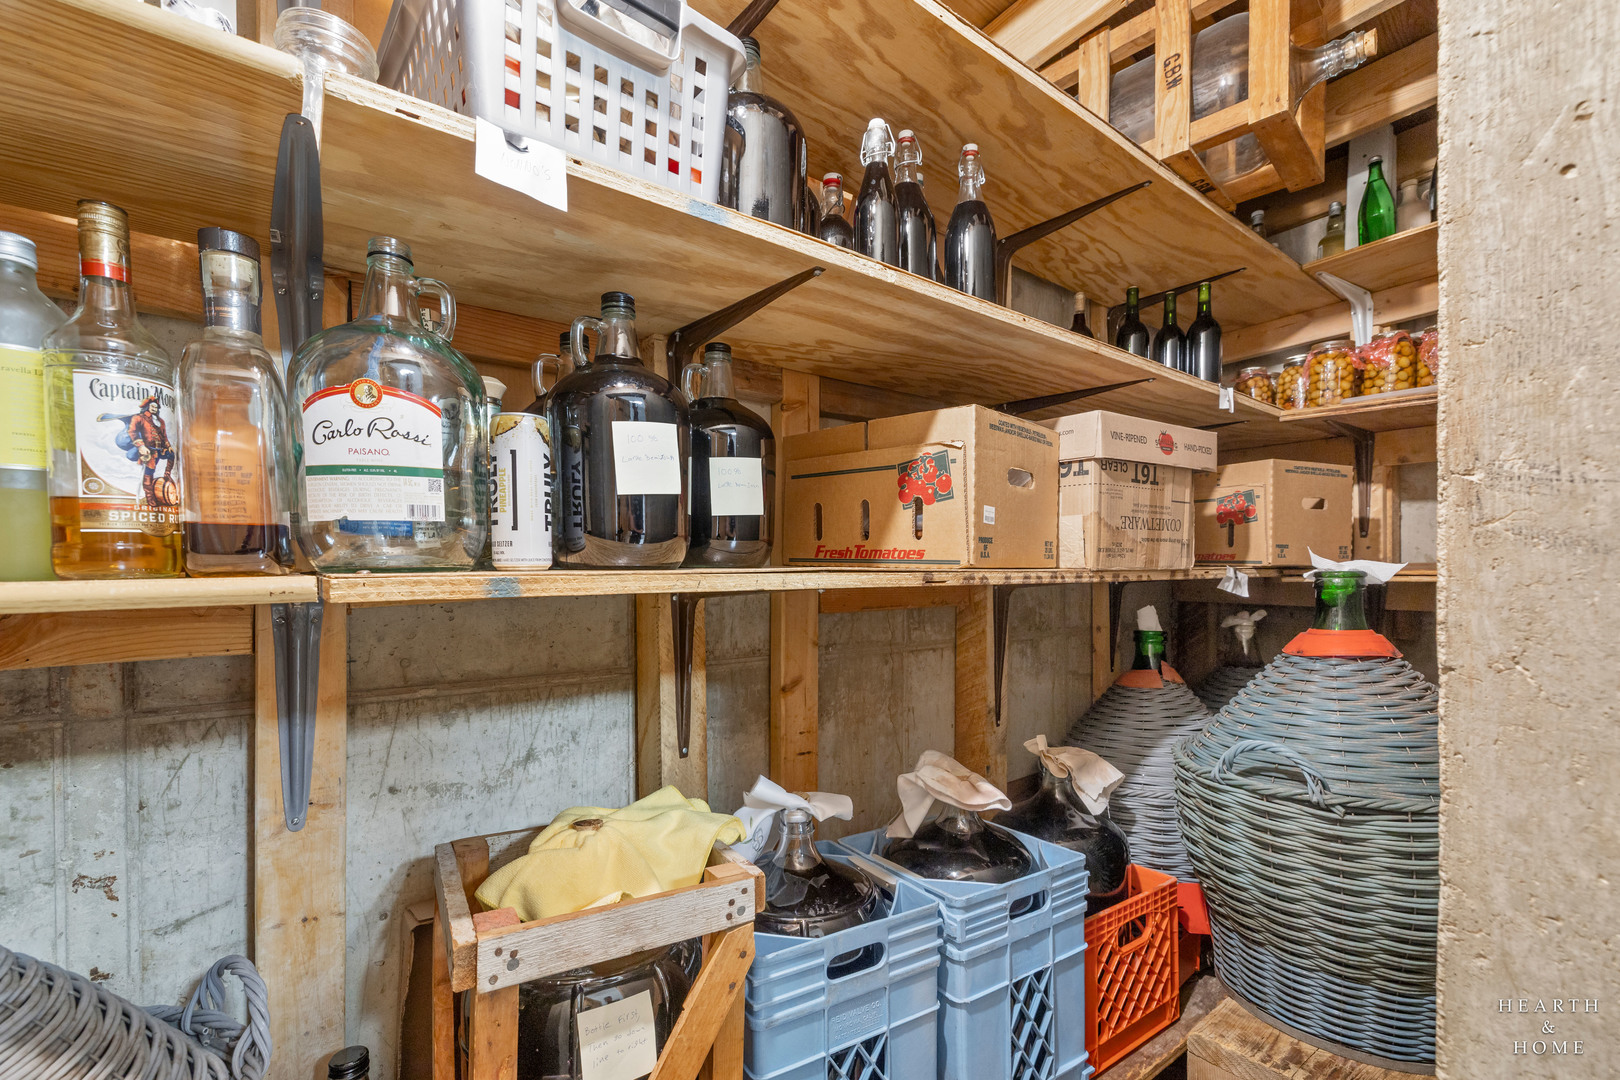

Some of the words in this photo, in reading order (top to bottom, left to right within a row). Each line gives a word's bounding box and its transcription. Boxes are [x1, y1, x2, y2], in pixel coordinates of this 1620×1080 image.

[0, 366, 32, 375] ravella
[89, 377, 149, 401] Captain
[312, 418, 364, 446] Carlo
[367, 417, 432, 446] Rossi
[1110, 430, 1148, 445] VINE-RIPENED
[1183, 442, 1213, 456] HAND-PICKED
[1100, 459, 1128, 474] CLEAR
[1131, 463, 1159, 486] T6T
[498, 467, 507, 513] PINEAPPLE
[108, 510, 166, 523] SPICED
[169, 514, 180, 524] RU
[1120, 515, 1182, 532] COMETWARE
[978, 536, 993, 544] PRODUCE
[814, 544, 854, 559] Fresh
[854, 544, 926, 560] Tomatoes
[1195, 552, 1236, 560] matoes
[584, 1021, 611, 1037] Bottle
